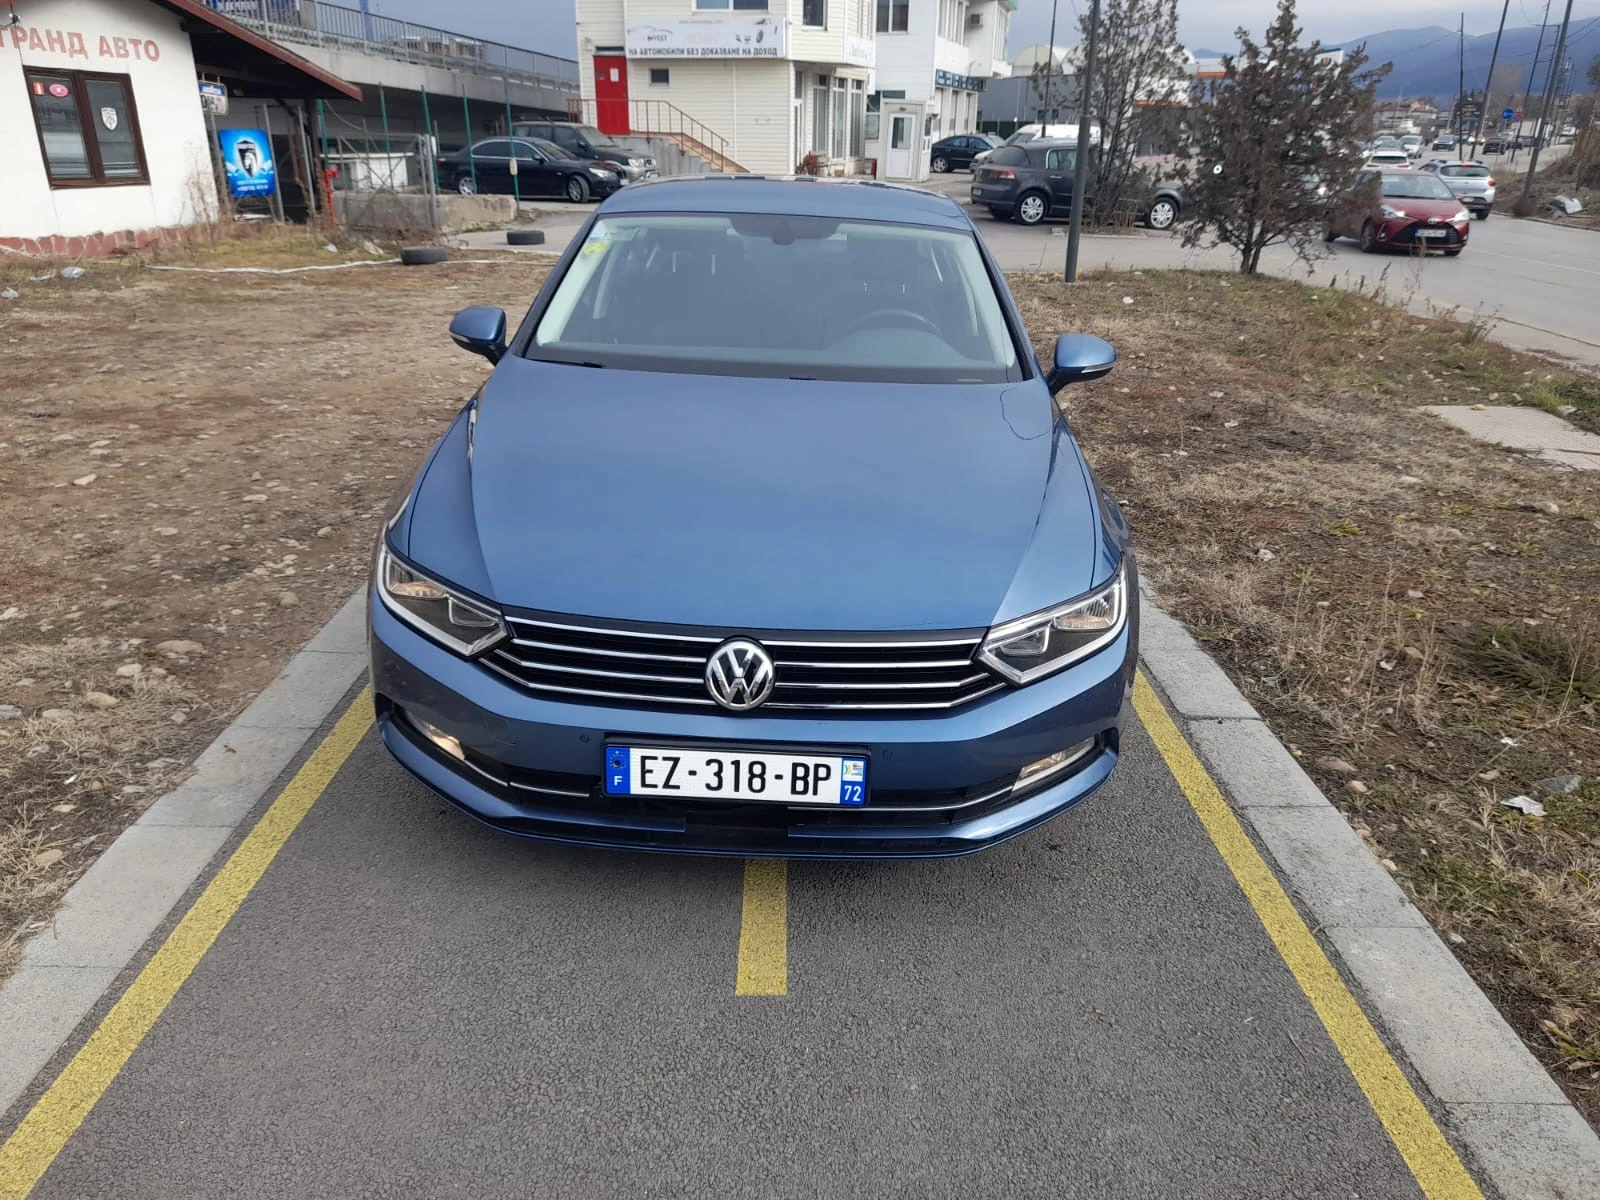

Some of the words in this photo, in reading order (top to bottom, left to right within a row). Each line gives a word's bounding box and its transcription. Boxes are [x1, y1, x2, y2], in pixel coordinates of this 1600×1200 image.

[98, 35, 161, 62] АВТО
[629, 47, 638, 56] НА
[640, 47, 685, 56] АВТОМОБИЛИ
[686, 47, 700, 56] БЕЗ
[701, 47, 740, 56] ДОКАЗВАНЕ
[742, 47, 752, 56] НА
[753, 47, 778, 57] ДОХОД
[613, 775, 623, 786] F
[640, 755, 832, 796] EZ-318-BP
[844, 784, 862, 802] 72
